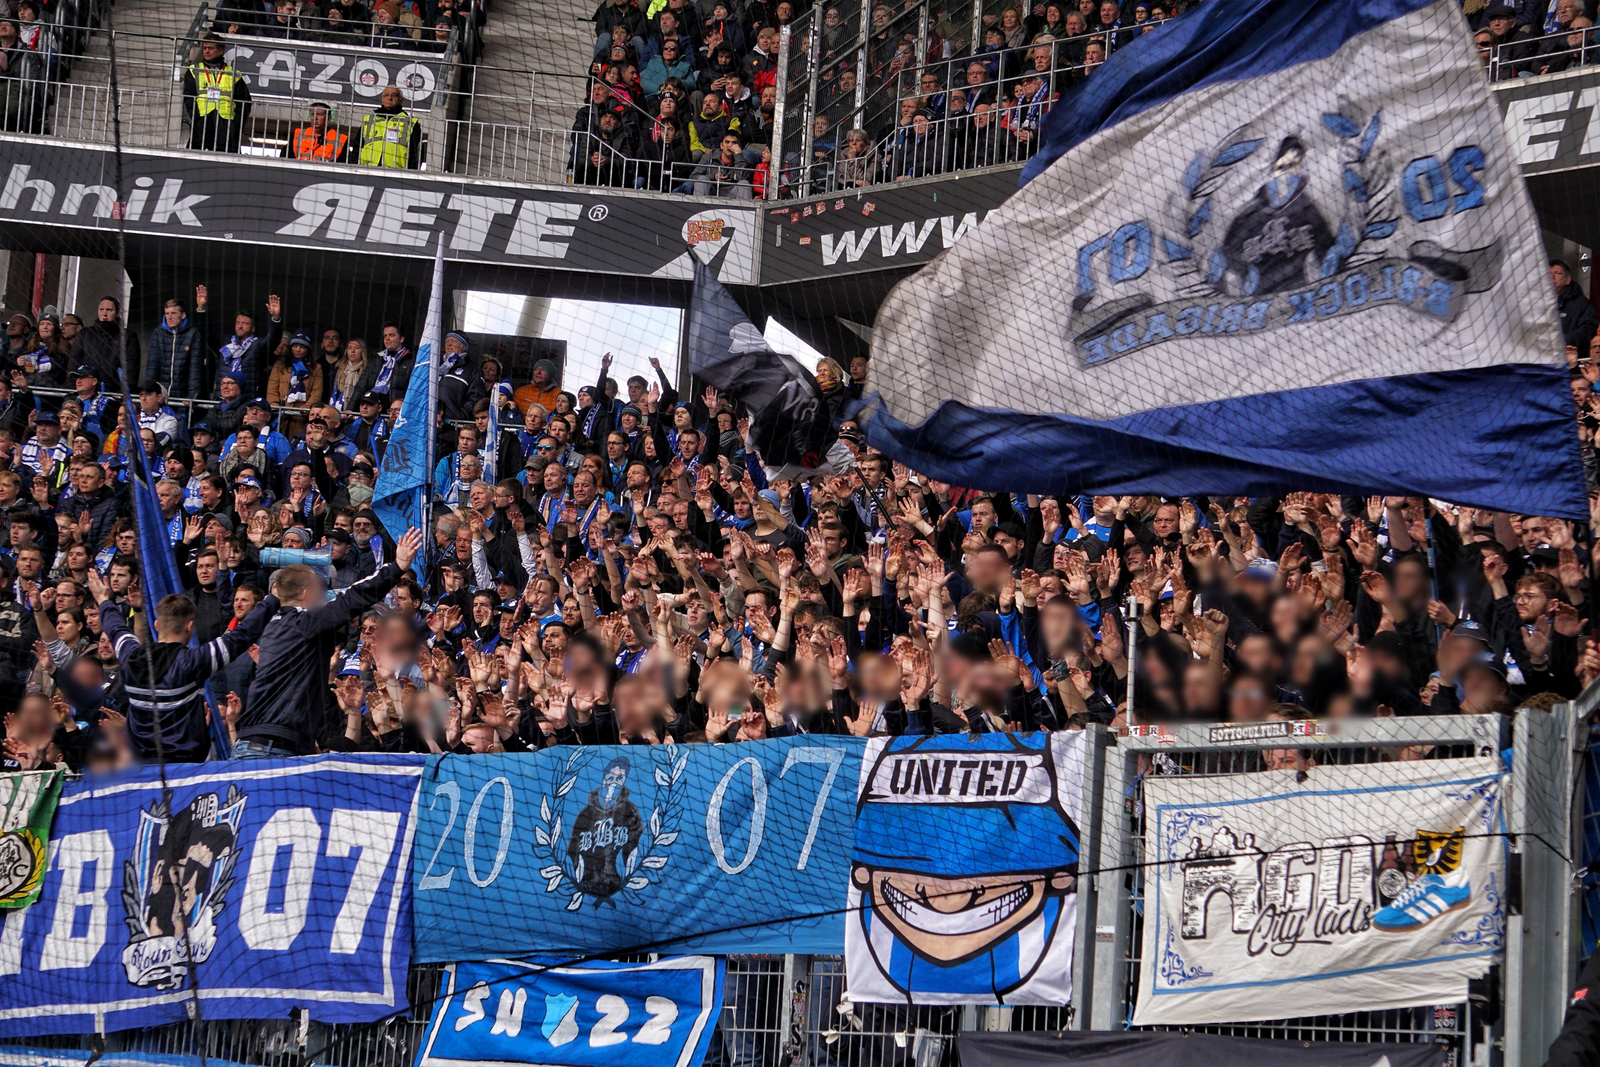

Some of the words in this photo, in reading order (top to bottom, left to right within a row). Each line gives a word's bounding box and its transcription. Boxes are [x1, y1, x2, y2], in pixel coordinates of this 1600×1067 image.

[1210, 722, 1287, 741] SOTTOCULTURA
[889, 758, 1028, 797] UNITED
[418, 776, 515, 890] 20
[705, 746, 847, 875] 07
[238, 807, 402, 955] 07
[1247, 902, 1332, 957] City
[589, 994, 679, 1048] 22
